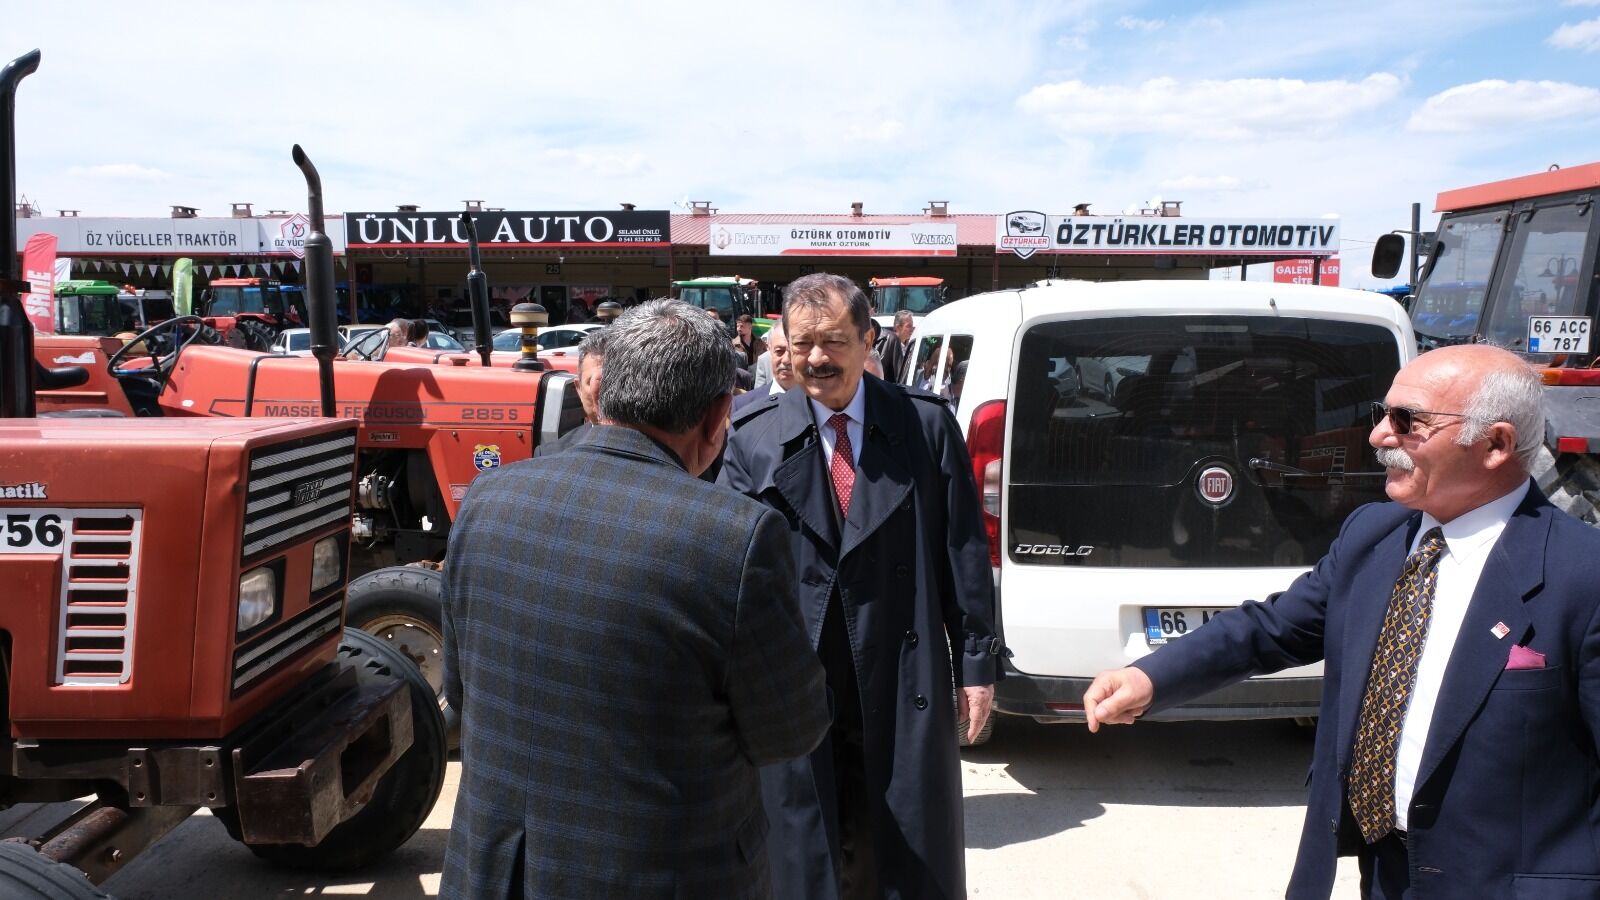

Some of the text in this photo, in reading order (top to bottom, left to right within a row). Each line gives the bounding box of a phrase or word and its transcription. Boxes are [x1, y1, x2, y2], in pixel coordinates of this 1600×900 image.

[356, 213, 614, 243] ÜNLÜ AUTO
[790, 228, 891, 240] ÖZTÜRK OTOMOTİV
[1056, 218, 1204, 246] ÖZTÜRKLER
[86, 230, 237, 247] ÖZ YÜCELLER TRAKTÖR
[734, 232, 780, 245] HATTAT
[911, 233, 955, 245] VALTRA
[1275, 264, 1339, 274] GALERİİLER
[1533, 320, 1588, 334] 66 ACC
[1553, 337, 1581, 351] 787
[264, 405, 319, 418] MASSE
[1207, 477, 1227, 494] FIAT
[0, 514, 63, 547] 56
[1015, 544, 1095, 556] DOBLO
[1160, 611, 1187, 635] 66
